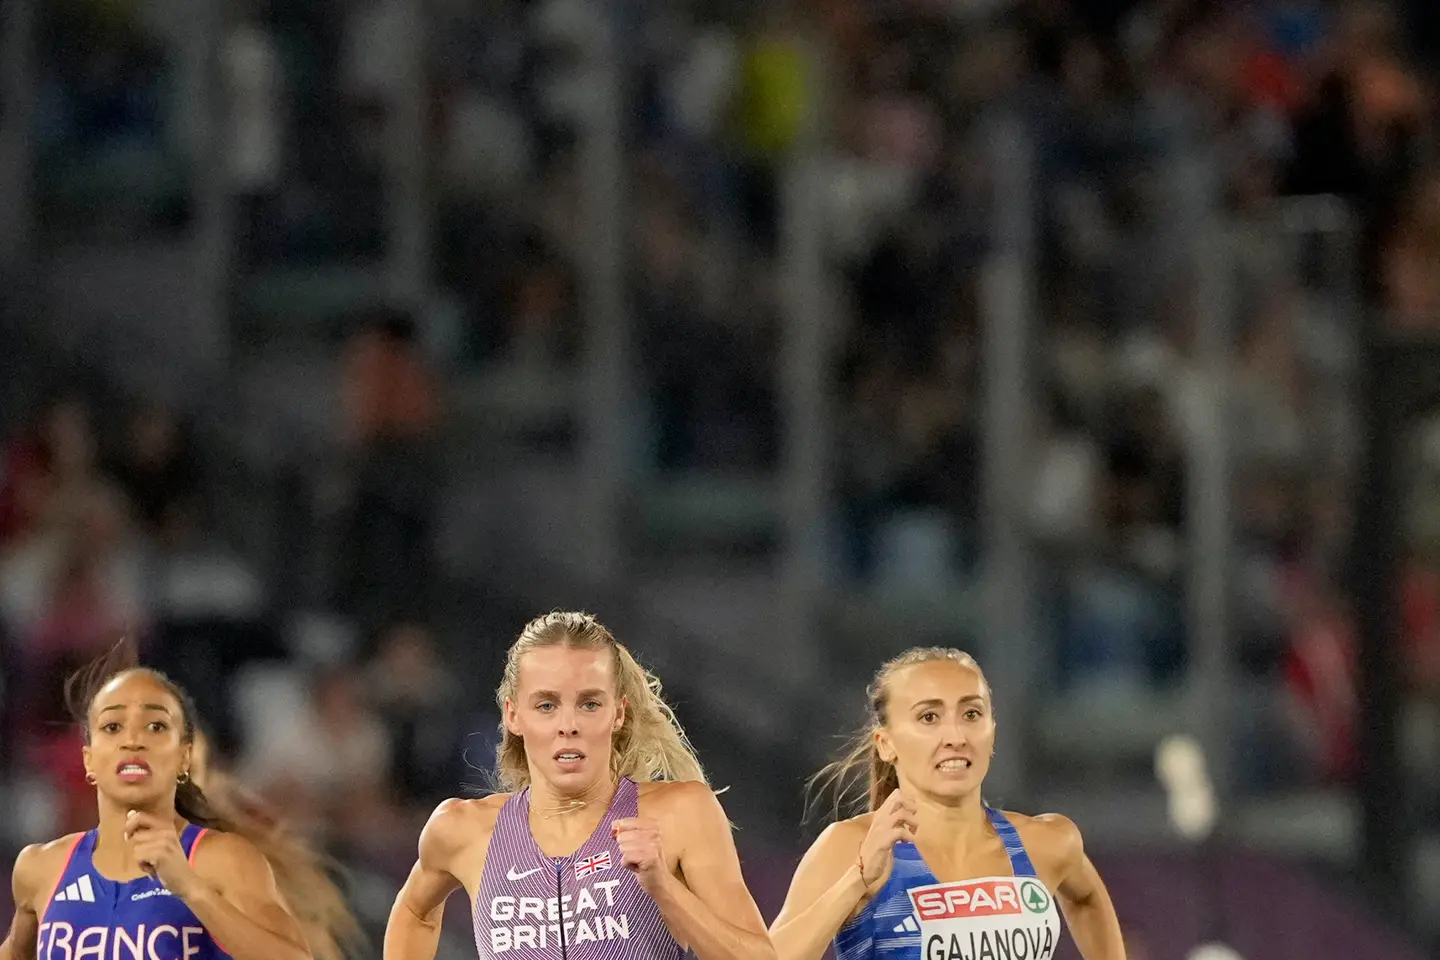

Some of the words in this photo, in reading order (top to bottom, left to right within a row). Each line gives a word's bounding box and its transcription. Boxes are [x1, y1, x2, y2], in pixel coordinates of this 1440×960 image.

[490, 879, 620, 921] GREAT
[917, 886, 1018, 916] SPAR
[490, 914, 630, 953] BRITAIN
